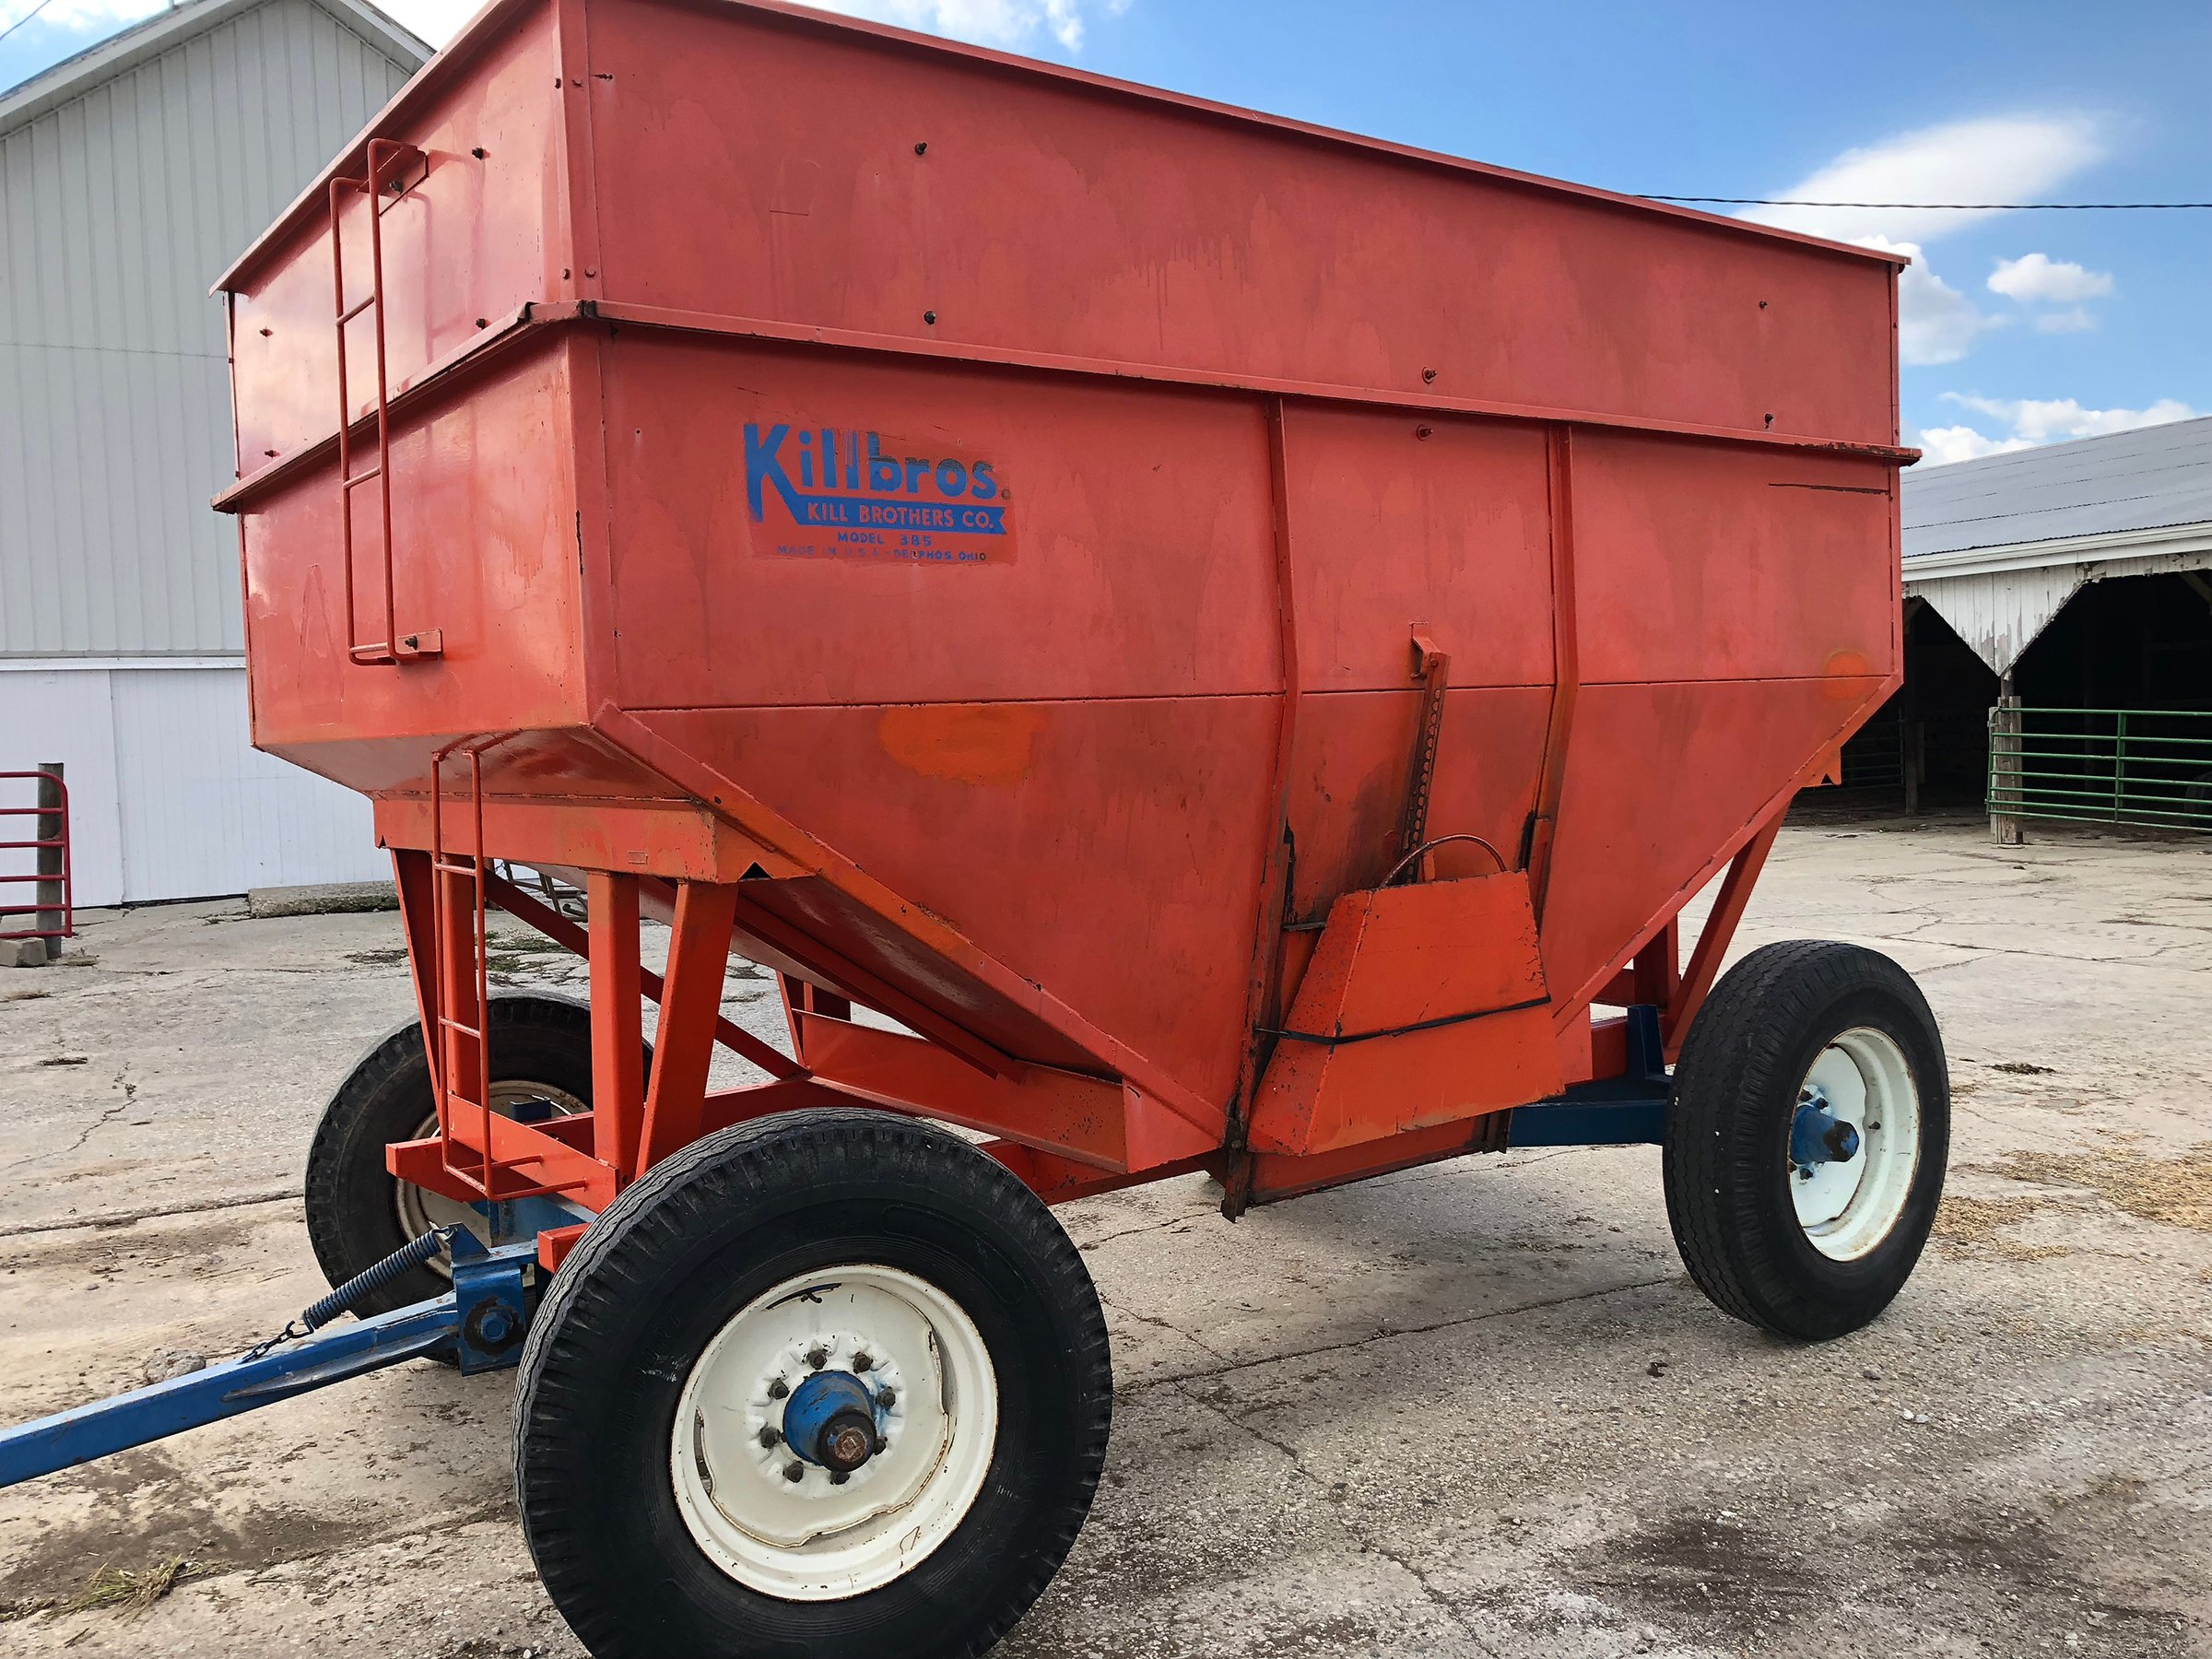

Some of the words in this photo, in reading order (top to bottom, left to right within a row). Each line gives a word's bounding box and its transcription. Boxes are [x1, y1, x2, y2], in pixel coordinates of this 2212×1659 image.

[744, 422, 998, 524] Killbros
[807, 501, 848, 523] KILL
[859, 504, 954, 528] BROTHERS
[962, 510, 994, 529] CO.
[837, 532, 885, 545] MODEL
